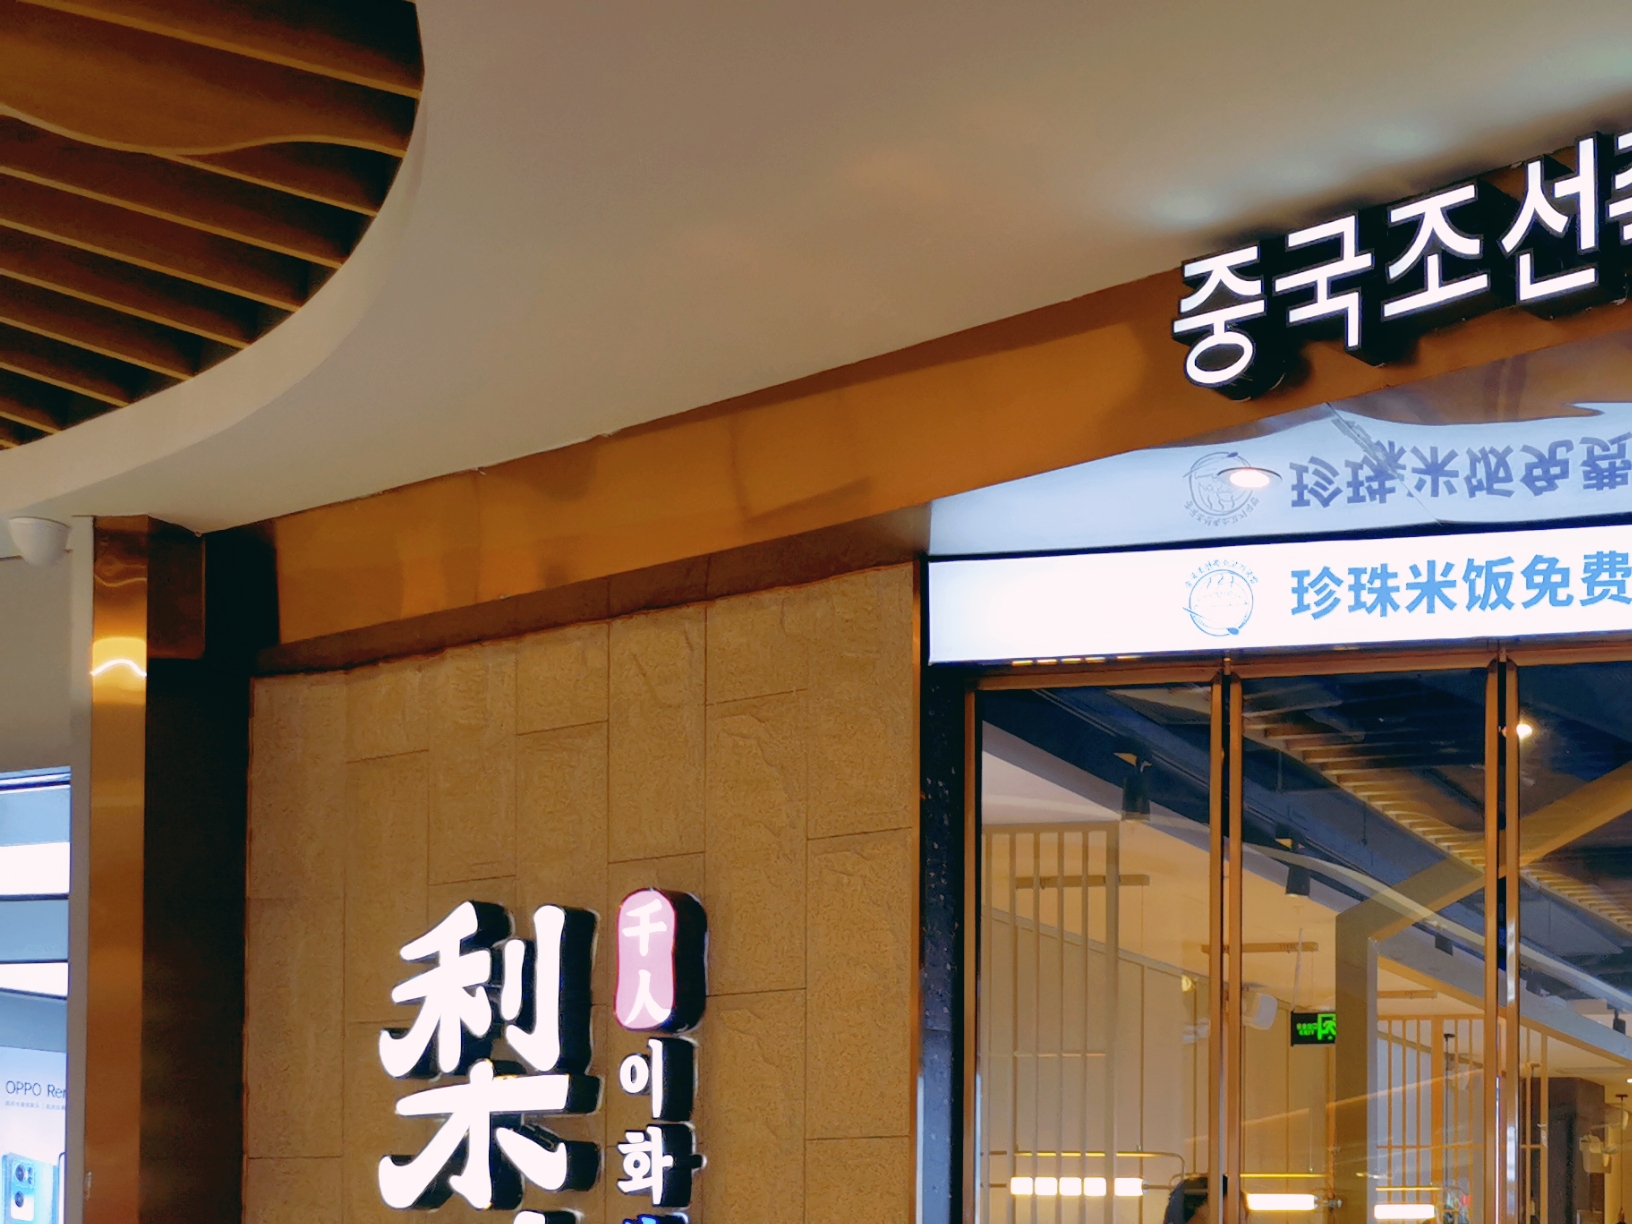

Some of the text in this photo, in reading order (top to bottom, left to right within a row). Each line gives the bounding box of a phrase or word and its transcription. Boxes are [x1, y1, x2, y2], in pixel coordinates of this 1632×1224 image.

[622, 898, 672, 1025] 千人
[5, 1080, 42, 1096] OPPO
[617, 1039, 673, 1205] 이화
